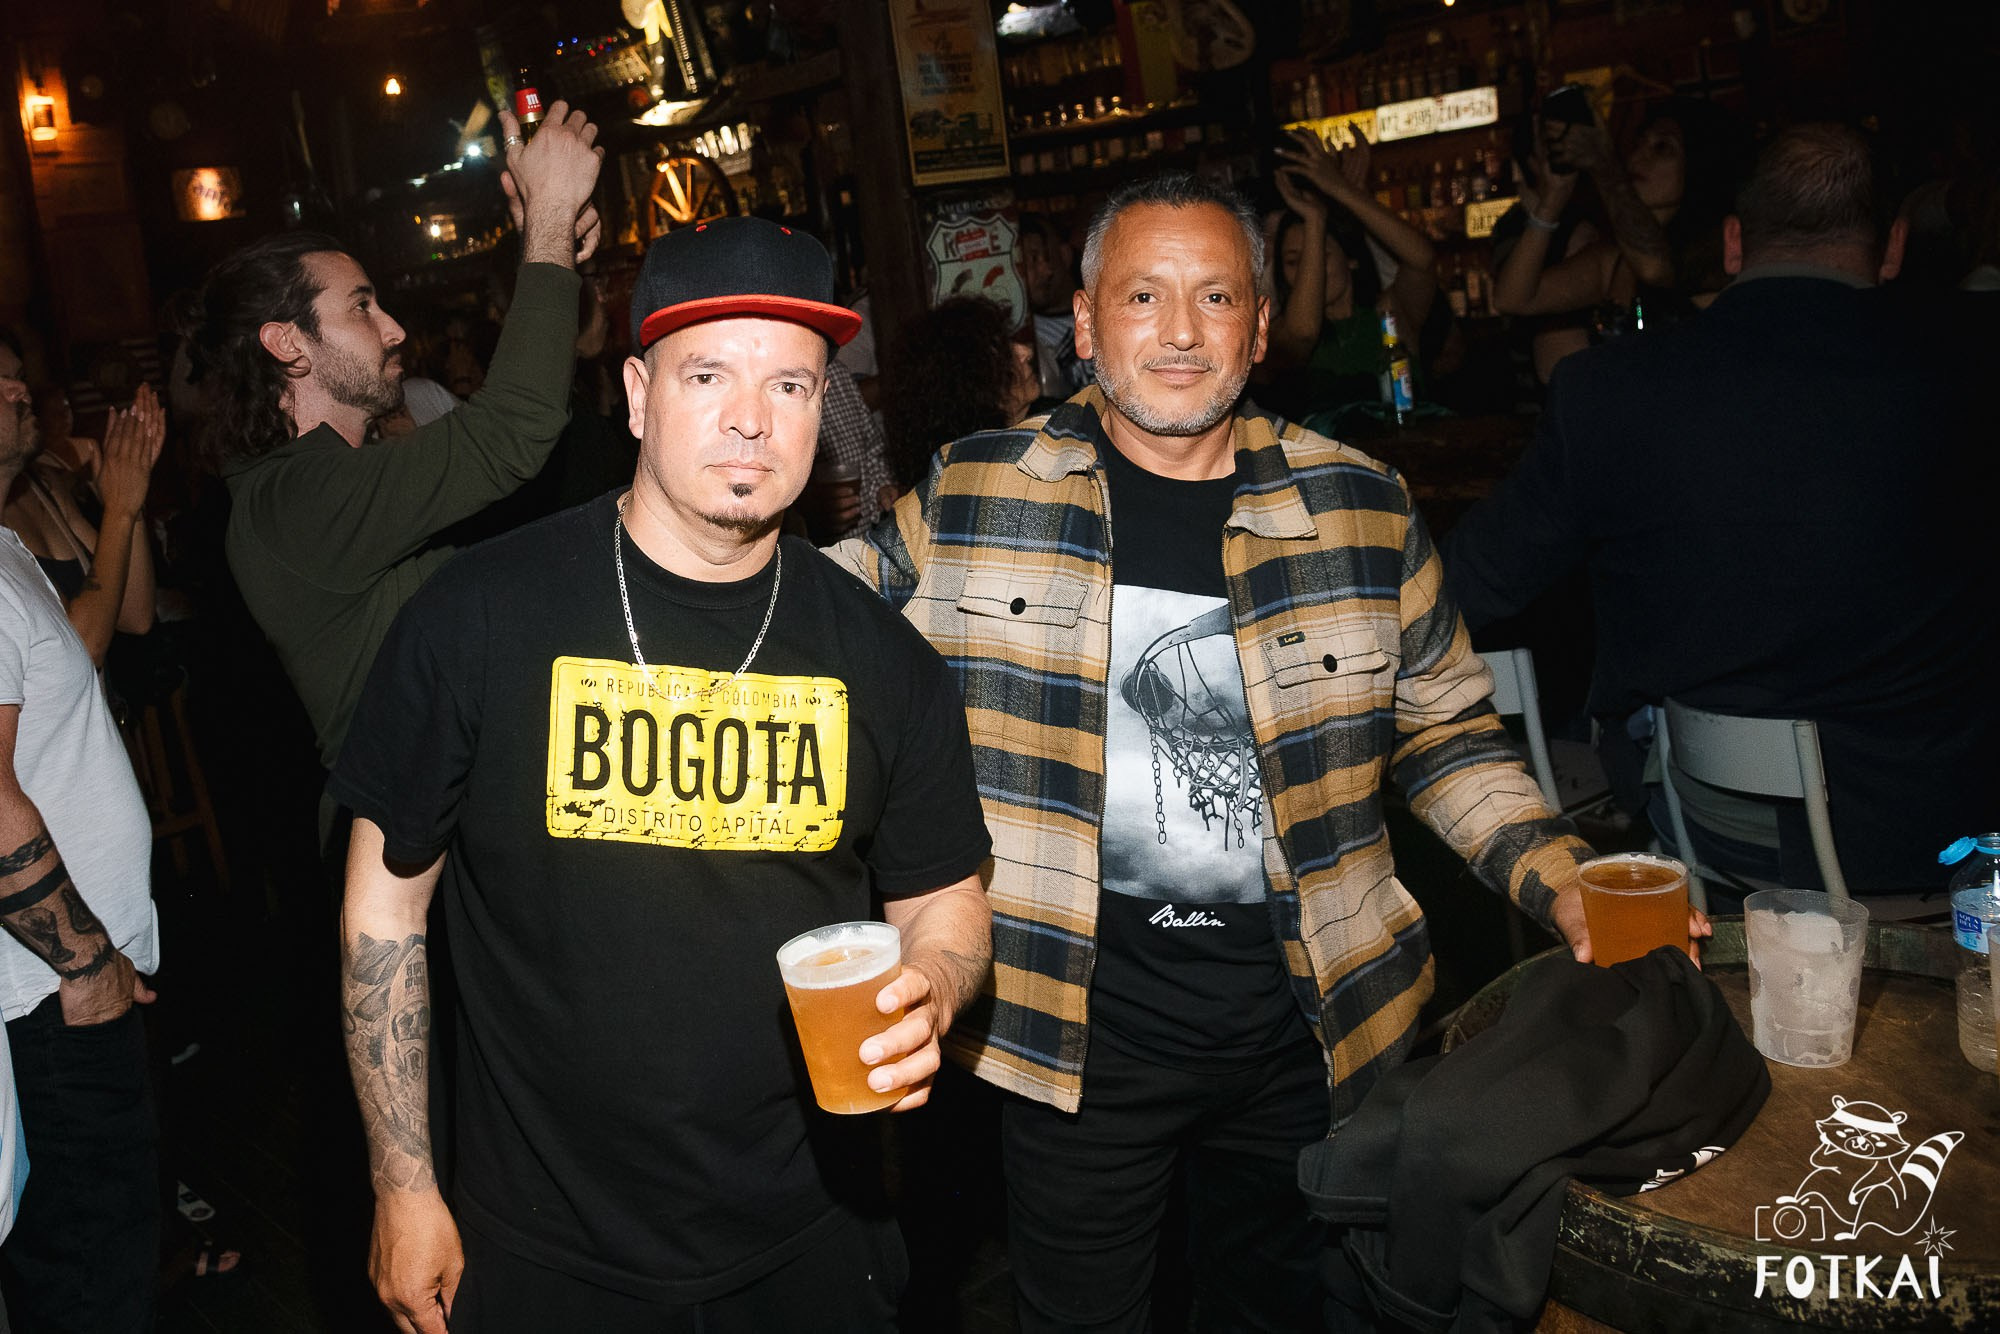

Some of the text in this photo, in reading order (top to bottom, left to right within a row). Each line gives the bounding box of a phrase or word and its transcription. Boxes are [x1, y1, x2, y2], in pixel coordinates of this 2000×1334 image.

[606, 677, 692, 698] REPUBICA
[723, 689, 798, 708] COLOMBIA
[571, 703, 827, 807] BOGOTA
[603, 806, 795, 836] DISTRITO CAPITAL
[1148, 903, 1226, 929] Ballin
